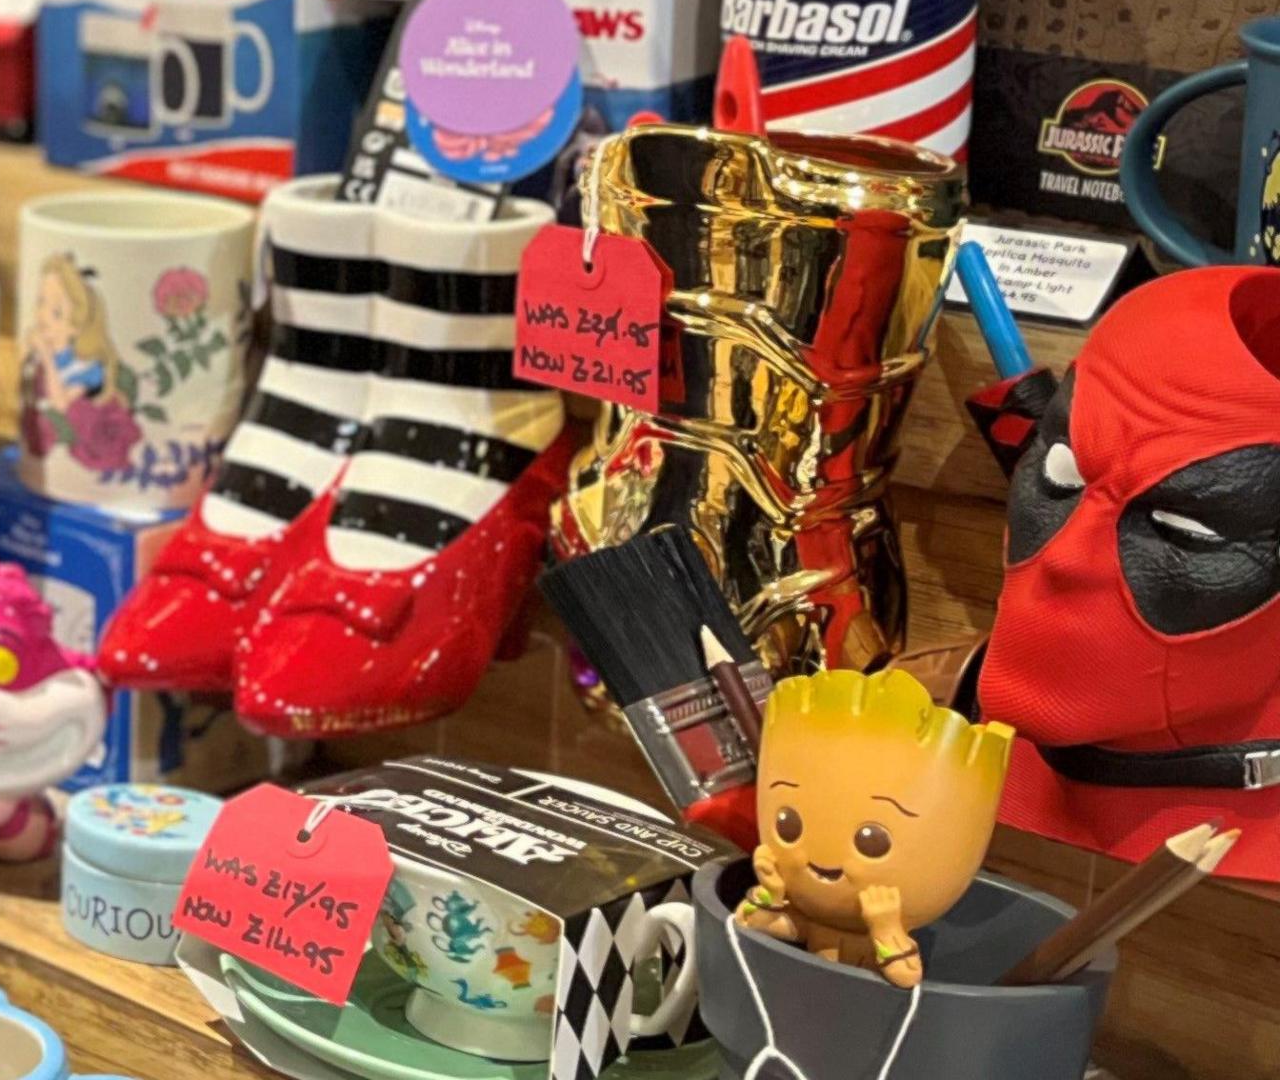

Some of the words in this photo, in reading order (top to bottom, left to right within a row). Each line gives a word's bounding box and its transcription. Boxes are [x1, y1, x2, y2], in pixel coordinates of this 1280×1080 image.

[573, 7, 645, 42] AWS
[492, 37, 513, 57] in
[819, 45, 870, 57] CREAM
[419, 56, 535, 79] Wonderland
[1044, 125, 1113, 156] JURASSIC
[1040, 171, 1079, 195] TRAVEL
[1081, 180, 1124, 203] NOTEB
[985, 247, 1028, 261] eplica
[1053, 241, 1086, 254] Park
[538, 795, 616, 826] SAUCER
[614, 821, 658, 840] AND
[656, 837, 702, 858] CUP
[203, 848, 259, 888] WAS
[66, 883, 181, 941] CURIOU
[182, 895, 232, 929] NOW
